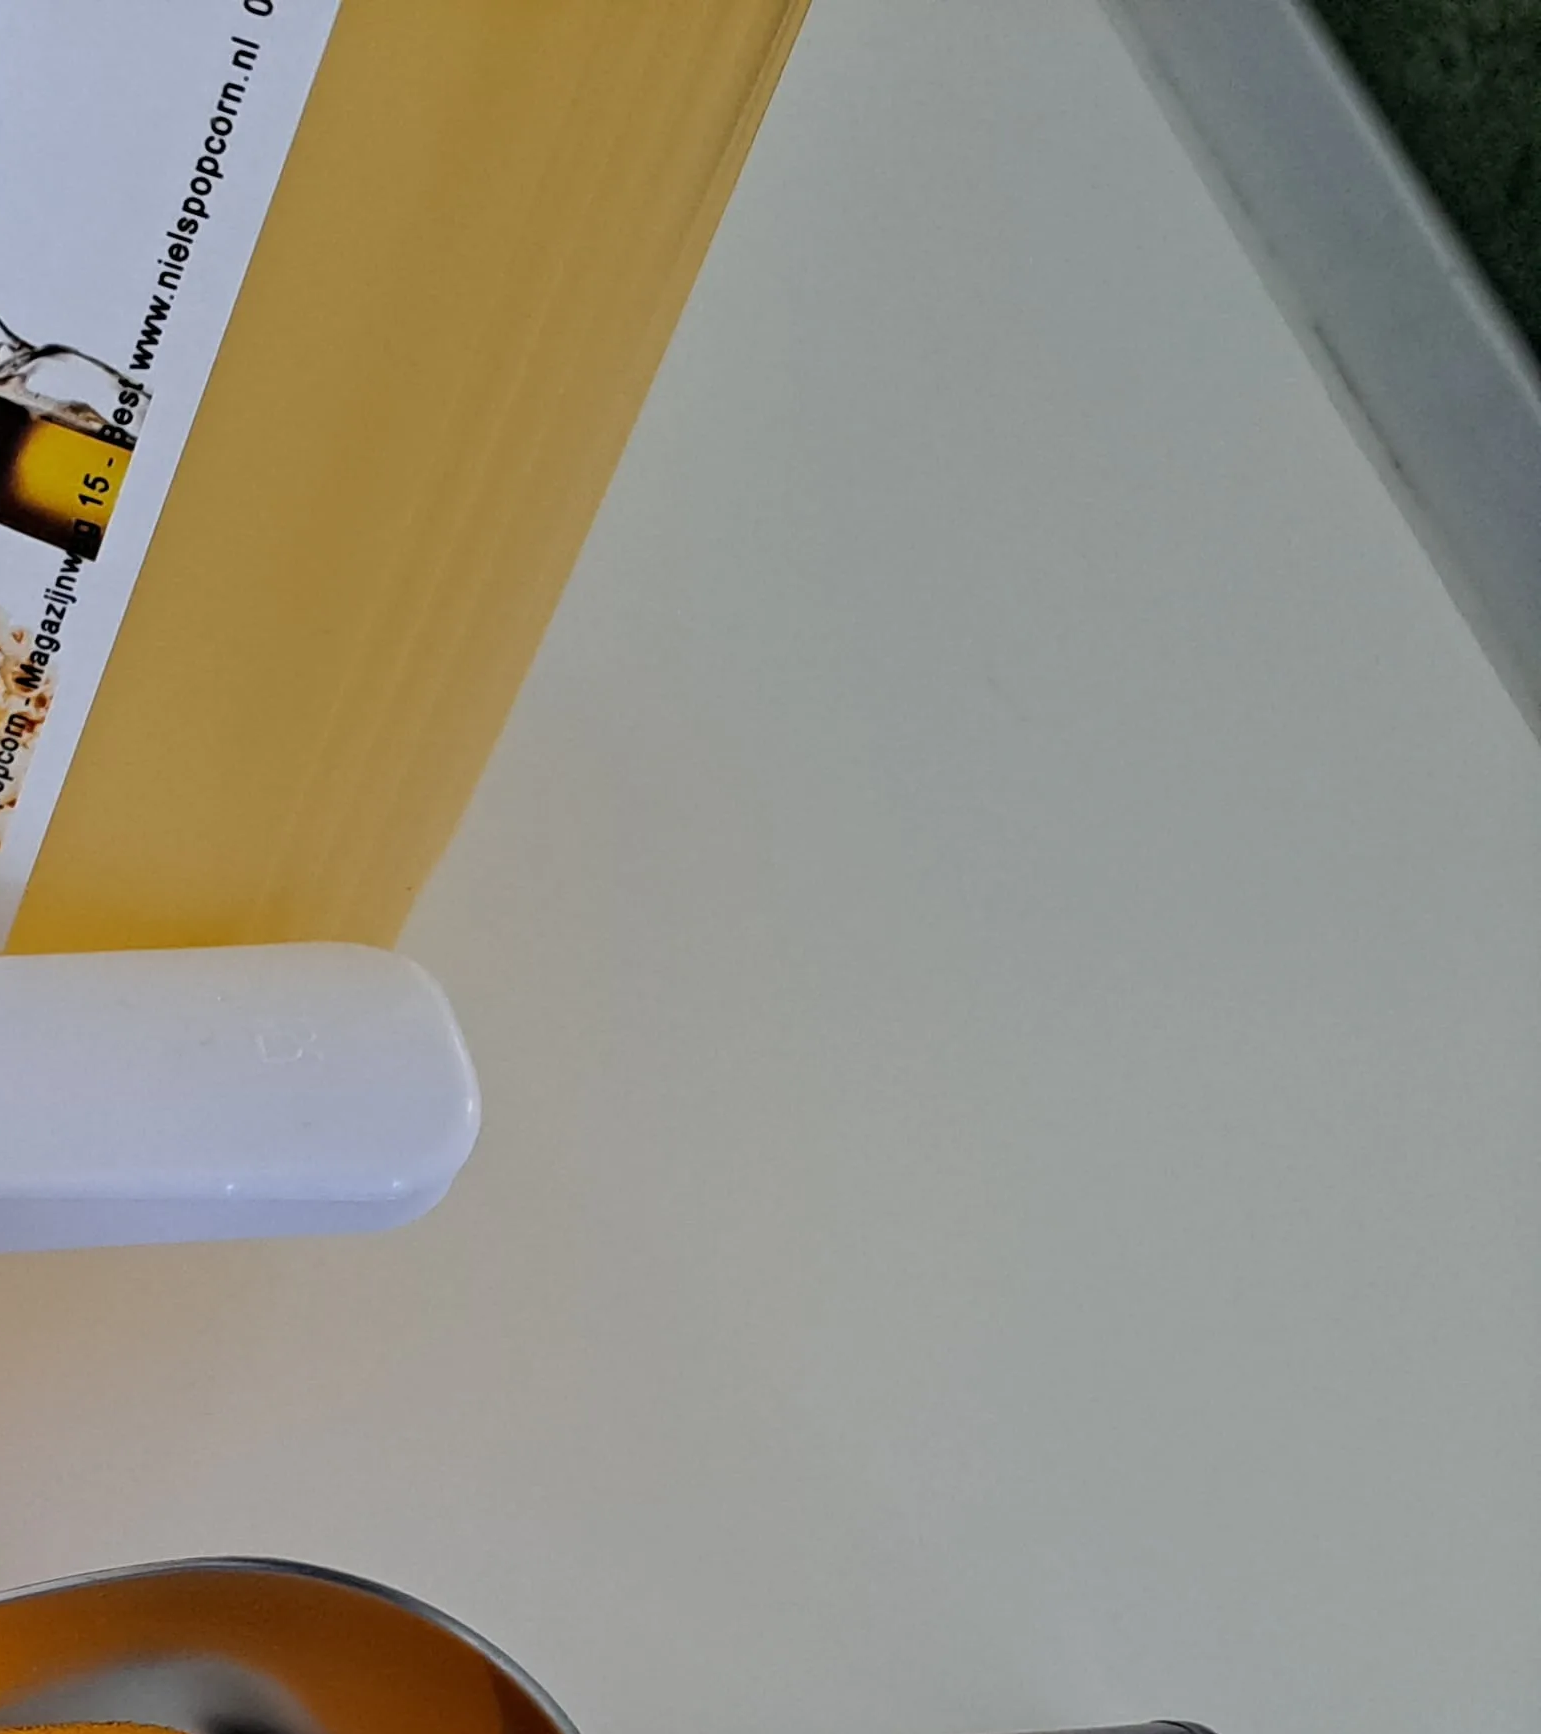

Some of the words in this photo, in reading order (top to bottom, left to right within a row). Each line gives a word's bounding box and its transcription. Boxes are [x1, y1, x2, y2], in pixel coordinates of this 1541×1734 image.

[14, 519, 102, 690] Magazijnweg
[78, 472, 110, 508] 15
[99, 378, 144, 448] Best
[130, 36, 259, 371] www.nielspopcorn.nl
